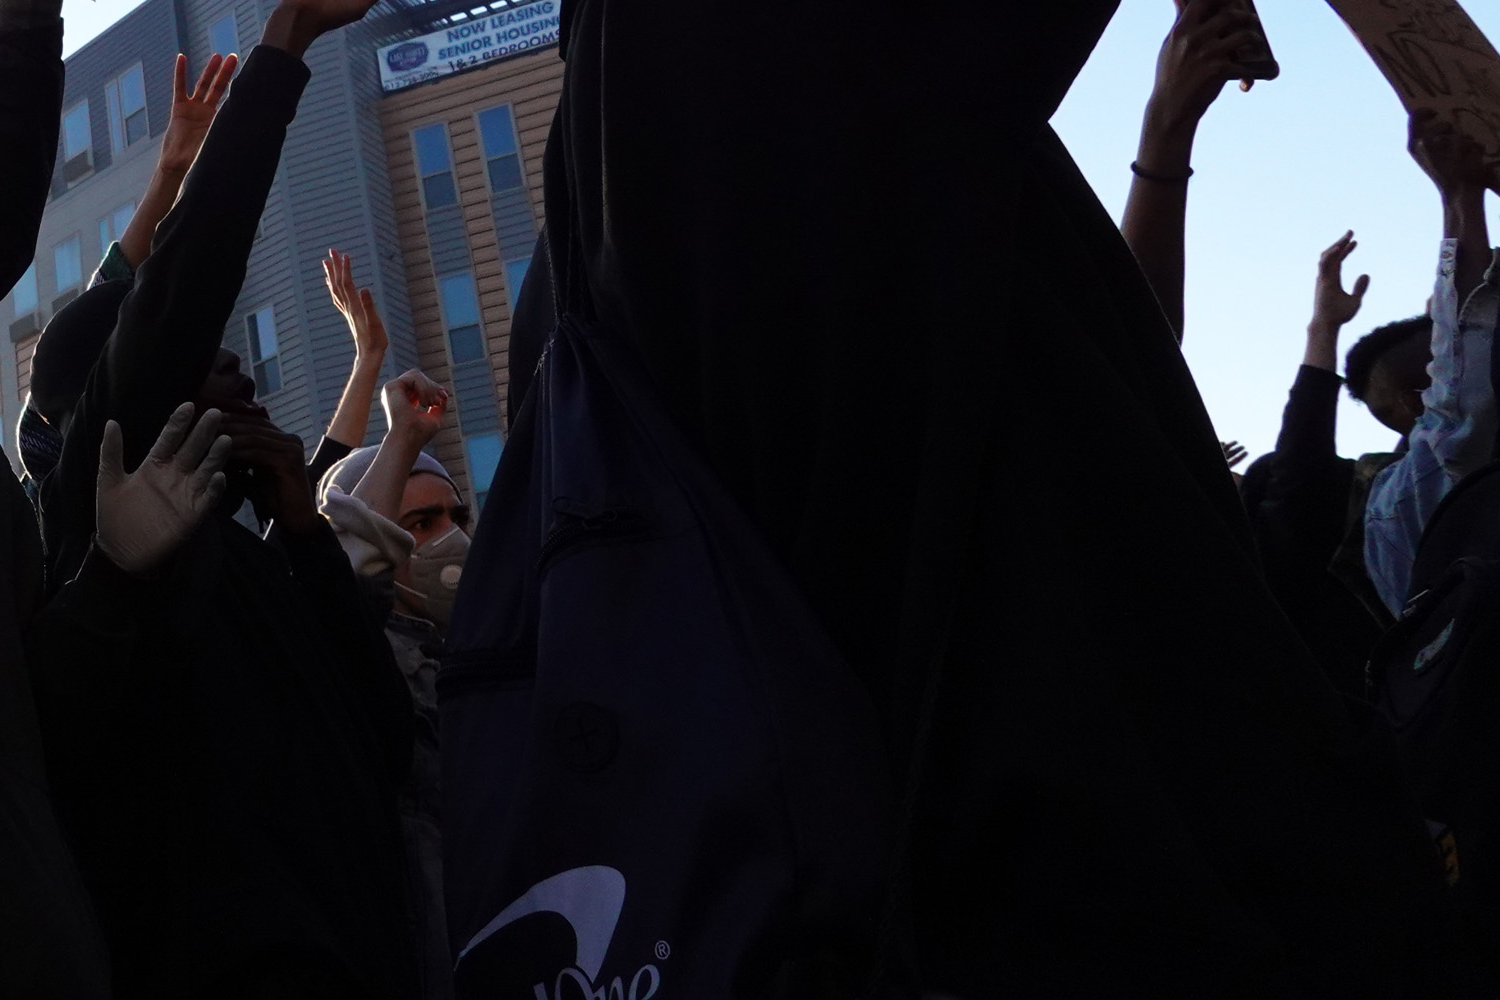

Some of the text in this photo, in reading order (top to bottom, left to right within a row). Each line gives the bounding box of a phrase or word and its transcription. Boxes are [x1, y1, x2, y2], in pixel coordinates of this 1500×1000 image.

[446, 1, 554, 43] NOW LEASING
[438, 36, 493, 60] SENIOR
